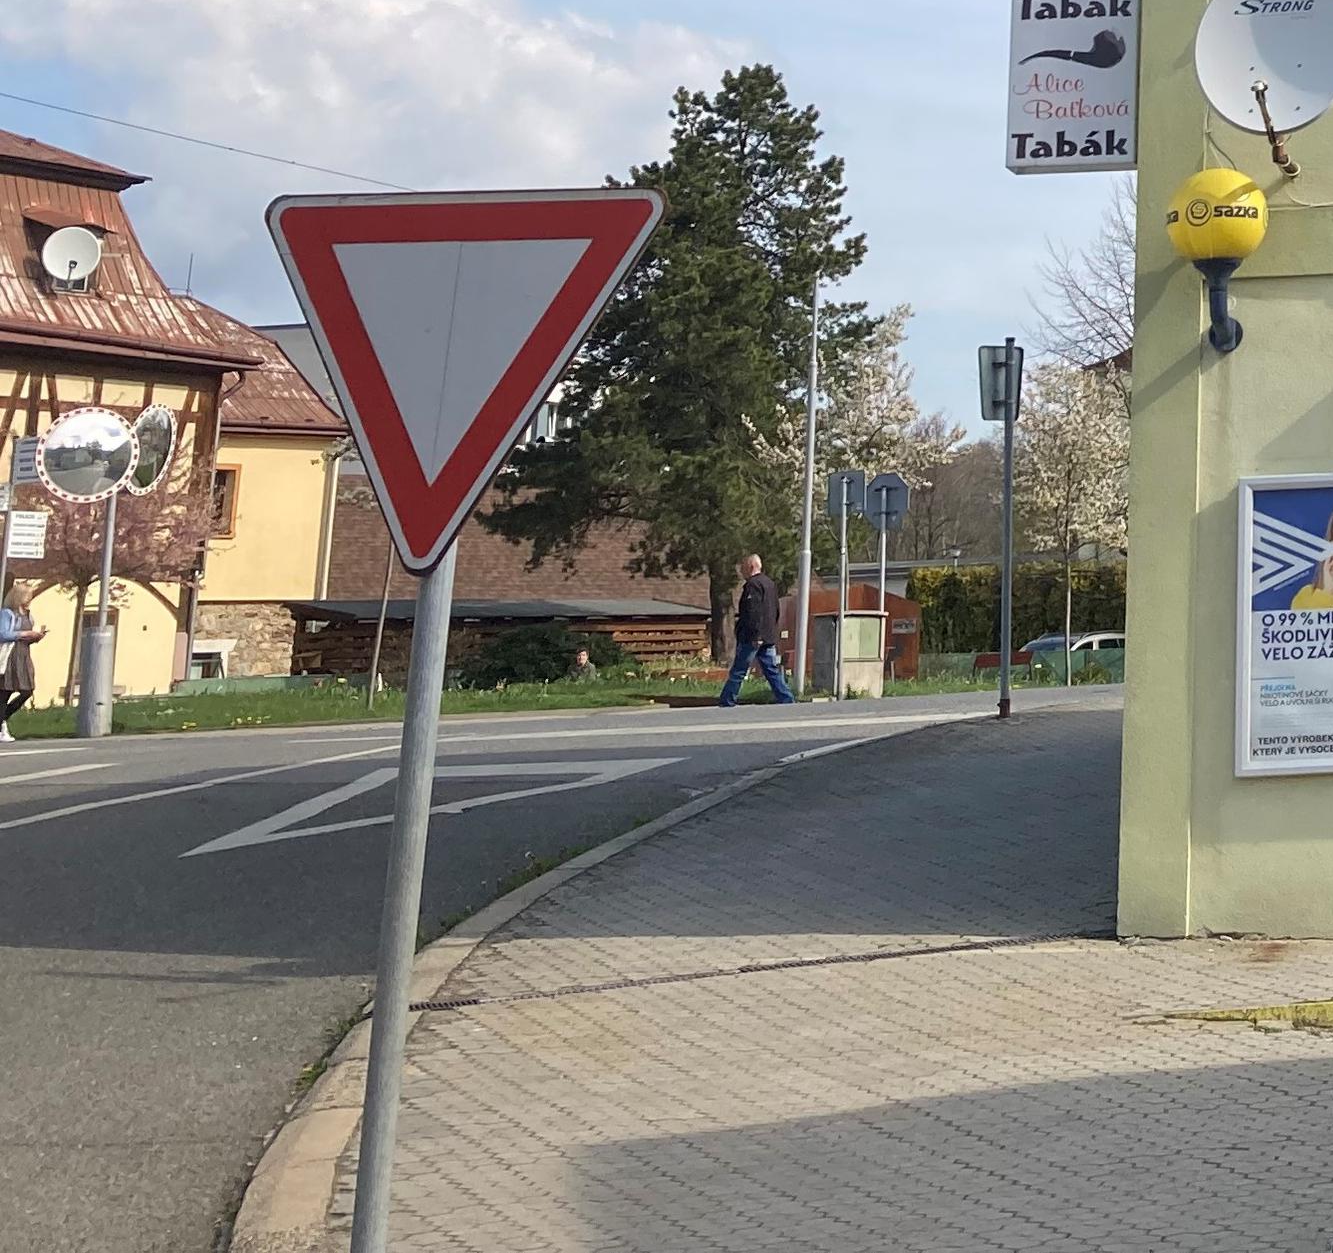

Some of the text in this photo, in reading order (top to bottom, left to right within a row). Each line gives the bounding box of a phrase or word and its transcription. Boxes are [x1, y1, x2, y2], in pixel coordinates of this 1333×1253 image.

[1234, 0, 1314, 15] STRONG
[1013, 73, 1085, 95] Alice
[1011, 129, 1128, 159] Tabák
[1262, 613, 1275, 627] O
[1278, 612, 1297, 626] 99
[1300, 611, 1314, 626] %
[1261, 646, 1304, 661] VELO
[1258, 736, 1288, 745] TENTO
[1290, 733, 1333, 744] VÝROBEK
[1285, 746, 1296, 755] JE
